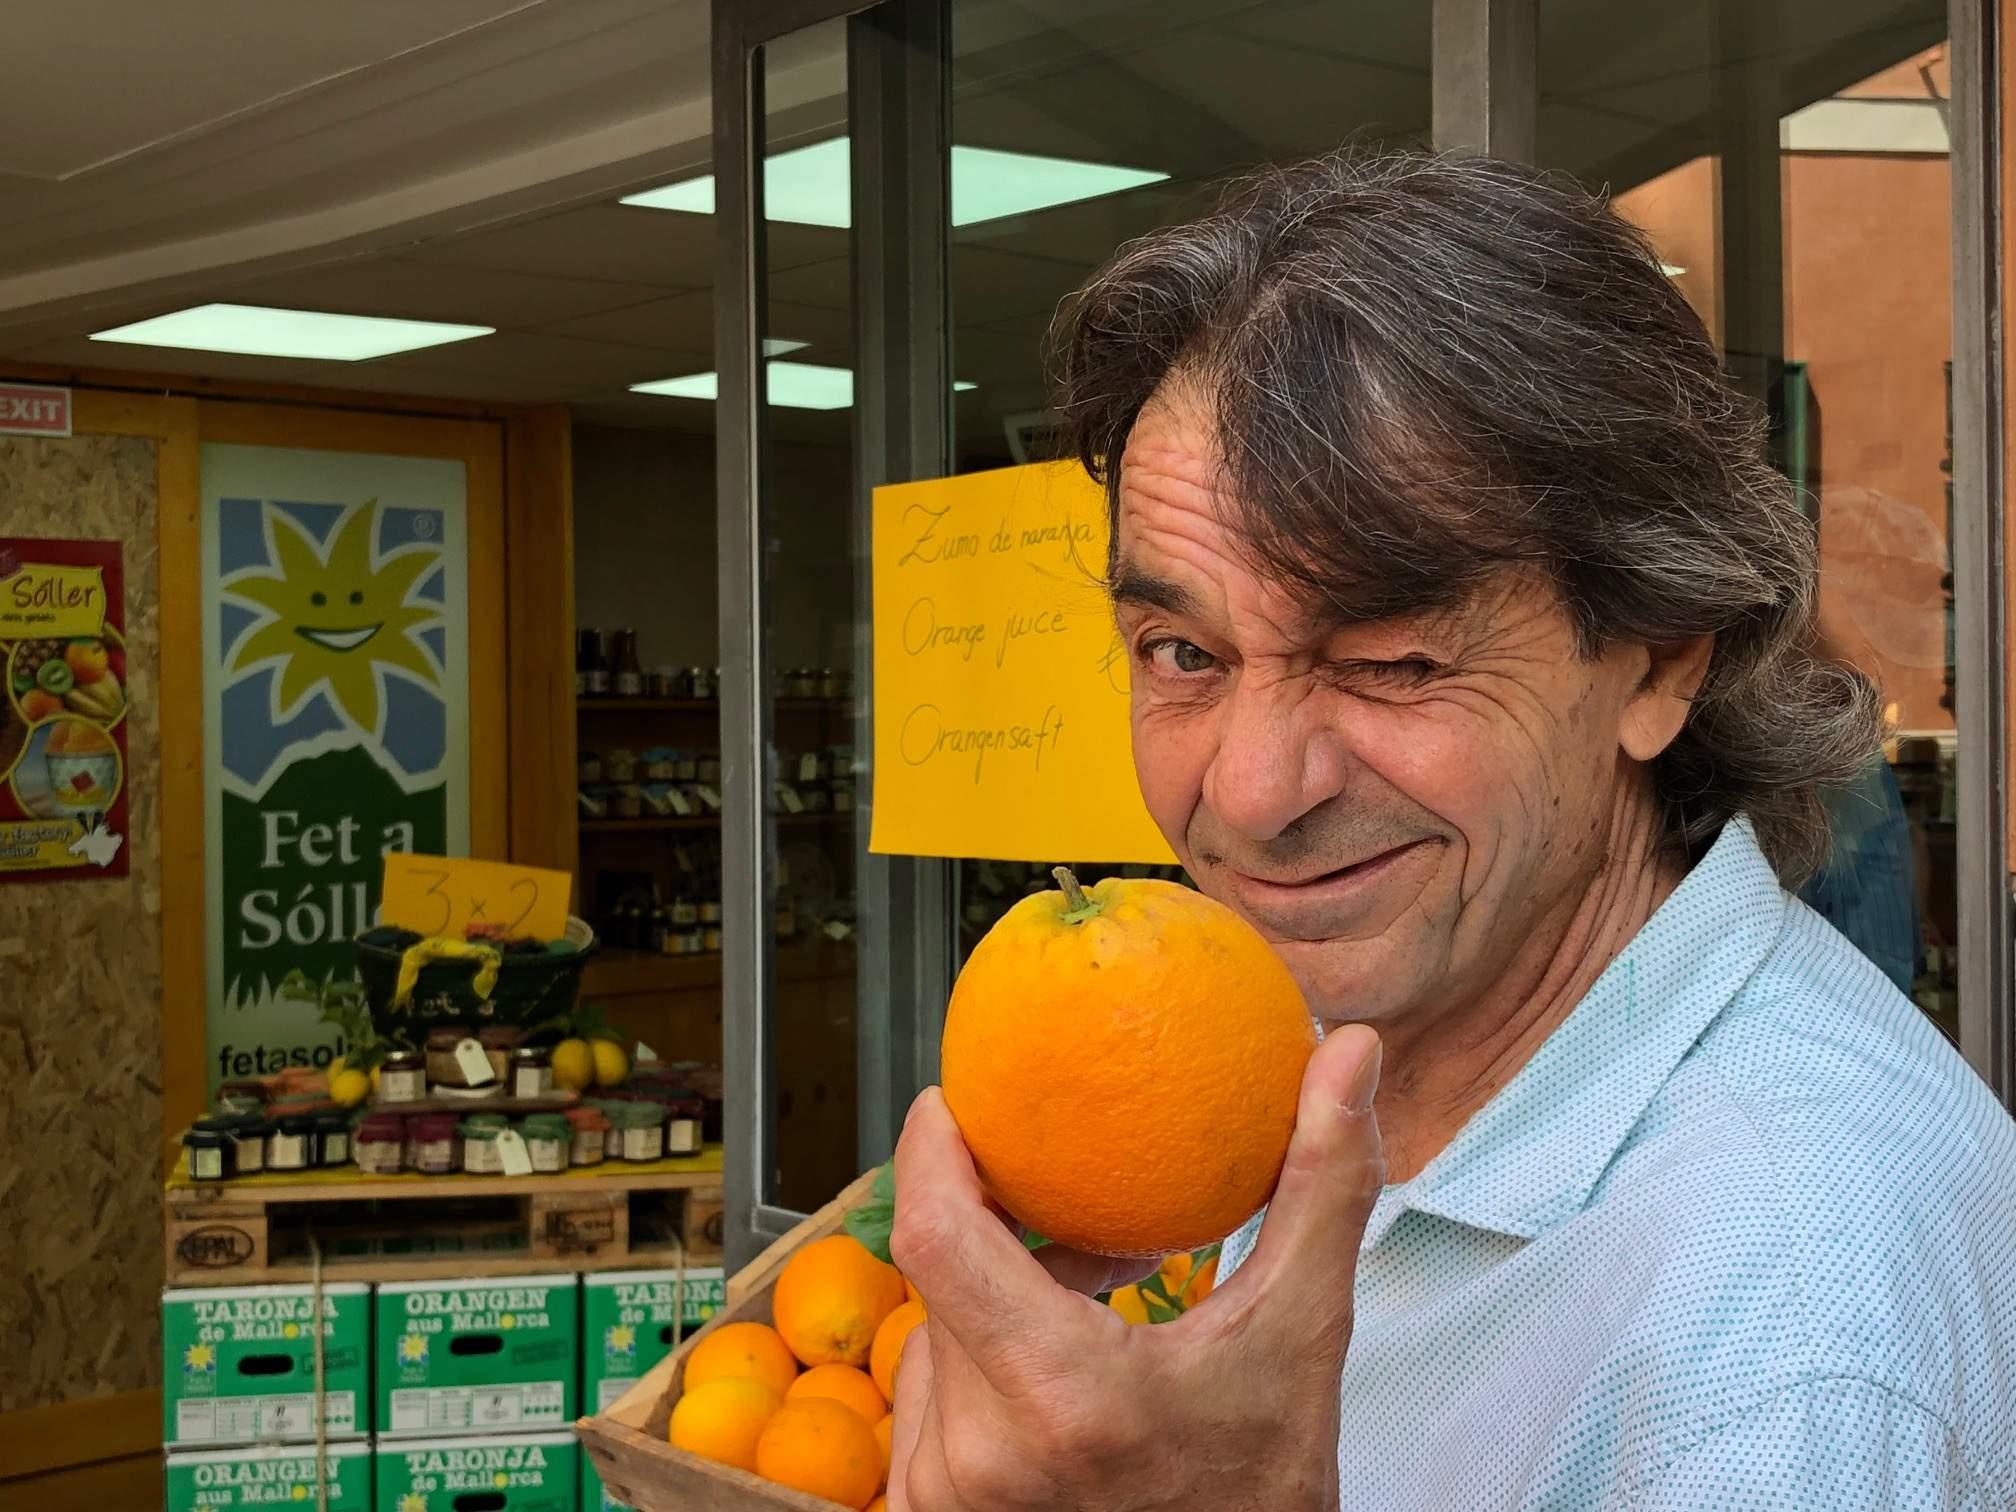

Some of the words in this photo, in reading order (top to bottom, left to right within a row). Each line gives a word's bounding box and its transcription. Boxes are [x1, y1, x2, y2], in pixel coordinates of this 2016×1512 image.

[898, 504, 980, 566] Zumo
[988, 516, 1013, 553] de
[1020, 522, 1095, 562] naranja
[903, 597, 985, 662] Orange
[901, 703, 1064, 785] Orangensaft
[260, 810, 361, 869] Fet
[381, 819, 415, 857] a
[240, 881, 384, 950] Sóll
[406, 868, 452, 938] 3
[505, 877, 539, 932] 2
[218, 1035, 350, 1078] fetasol
[193, 1296, 340, 1324] TARONJA
[405, 1287, 550, 1315] ORANGEN
[620, 1306, 645, 1324] de
[199, 1324, 226, 1342] de
[232, 1320, 336, 1341] Mallora
[406, 1317, 443, 1334] aus
[451, 1311, 550, 1333] Mallorca
[194, 1456, 341, 1487] ORANGEN
[406, 1446, 548, 1474] TARONJA
[196, 1488, 232, 1505] aus
[241, 1481, 343, 1502] Mallora
[411, 1474, 438, 1493] de
[445, 1468, 545, 1490] Mallorca
